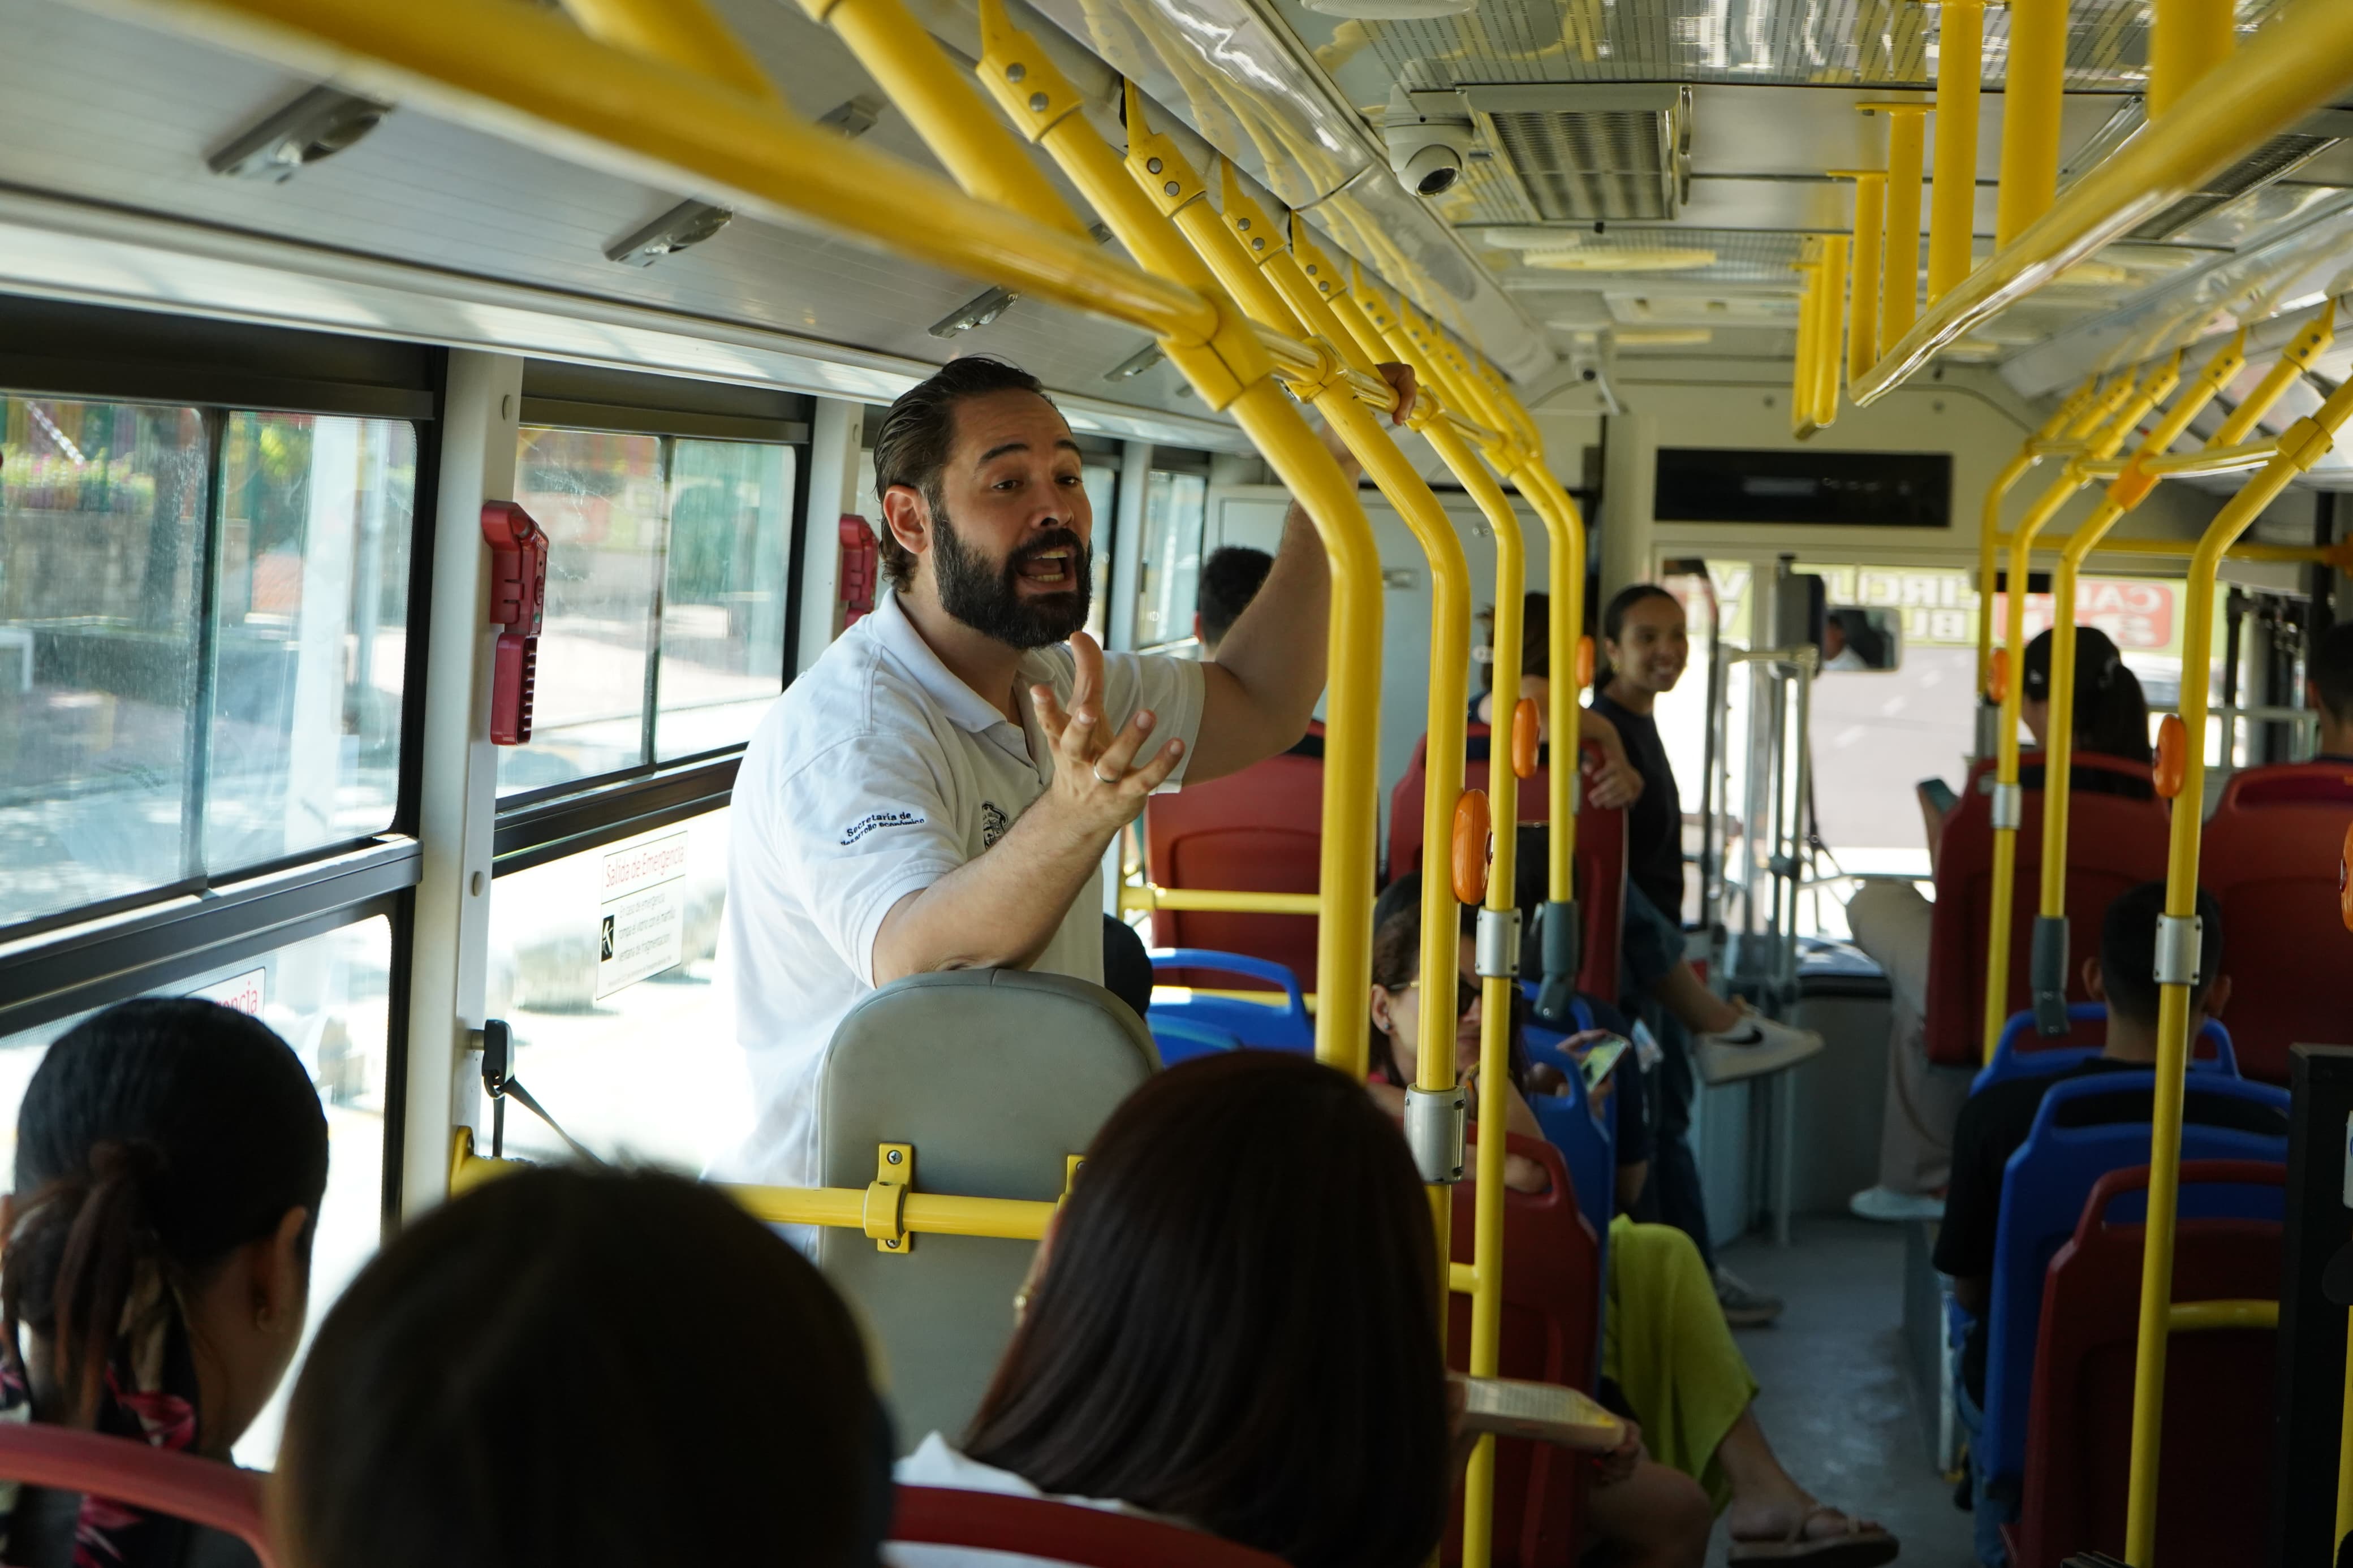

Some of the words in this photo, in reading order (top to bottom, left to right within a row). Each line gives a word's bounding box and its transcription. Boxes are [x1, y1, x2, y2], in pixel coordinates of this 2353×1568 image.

[847, 813, 897, 837] Secretaría
[899, 811, 912, 820] de
[606, 856, 630, 888] Salida
[631, 854, 641, 879] de
[643, 842, 685, 876] Emergencia
